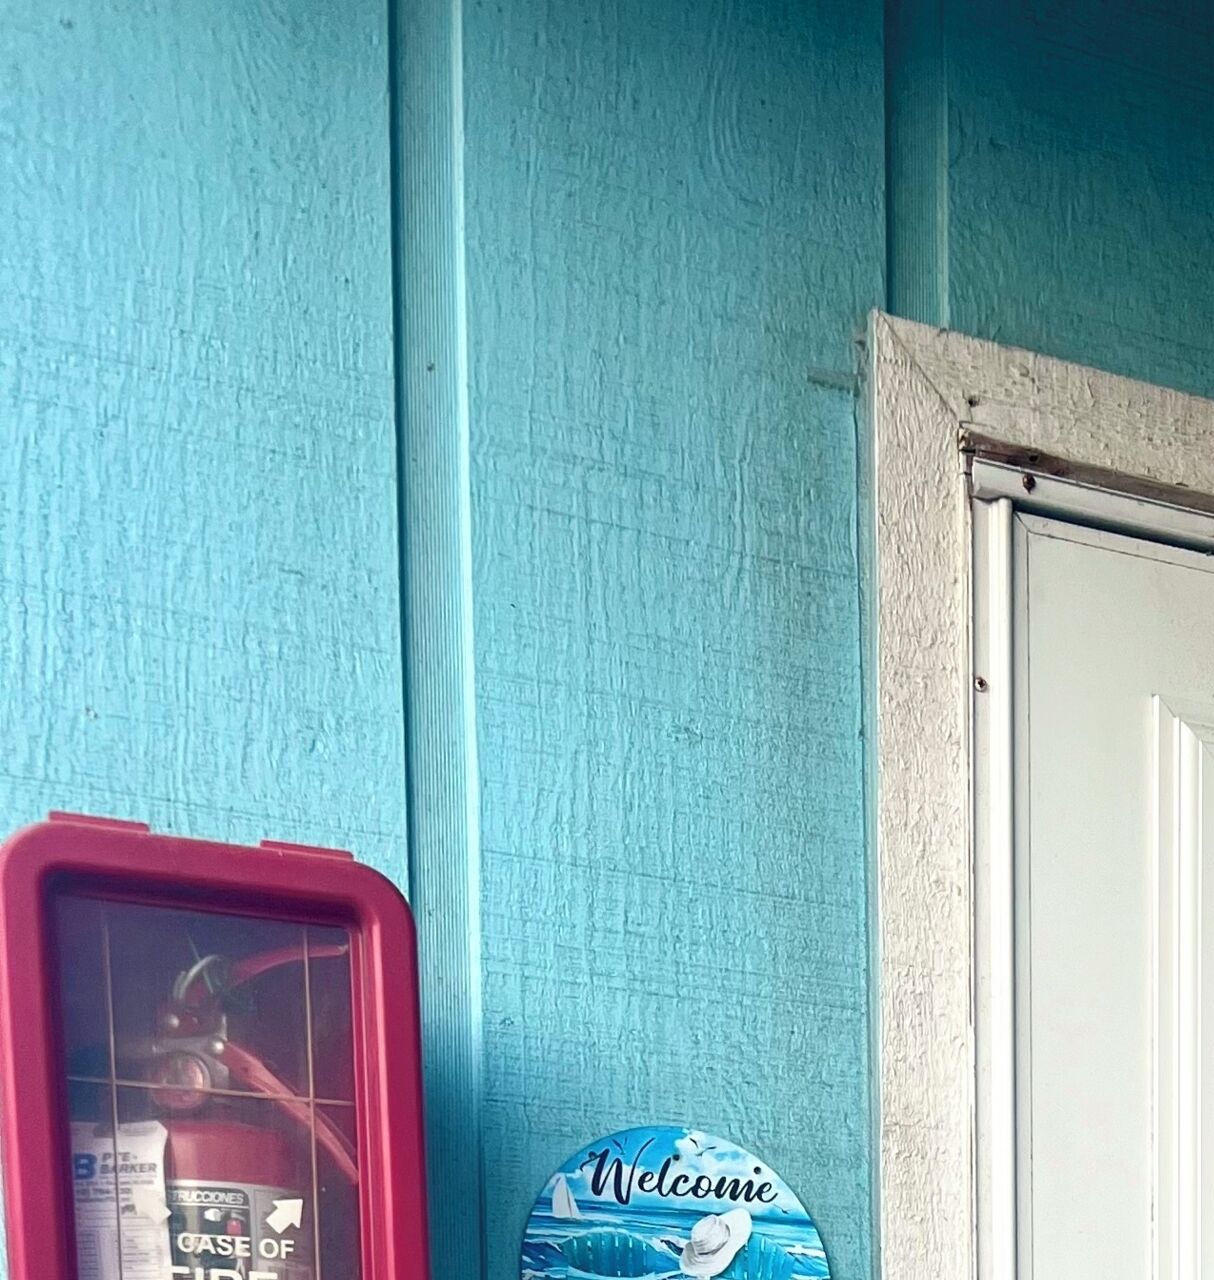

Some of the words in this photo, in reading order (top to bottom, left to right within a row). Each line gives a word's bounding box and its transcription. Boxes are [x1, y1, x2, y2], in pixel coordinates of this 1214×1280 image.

[580, 1137, 778, 1205] Welcome
[177, 1232, 251, 1257] CASE
[259, 1238, 295, 1259] OF
